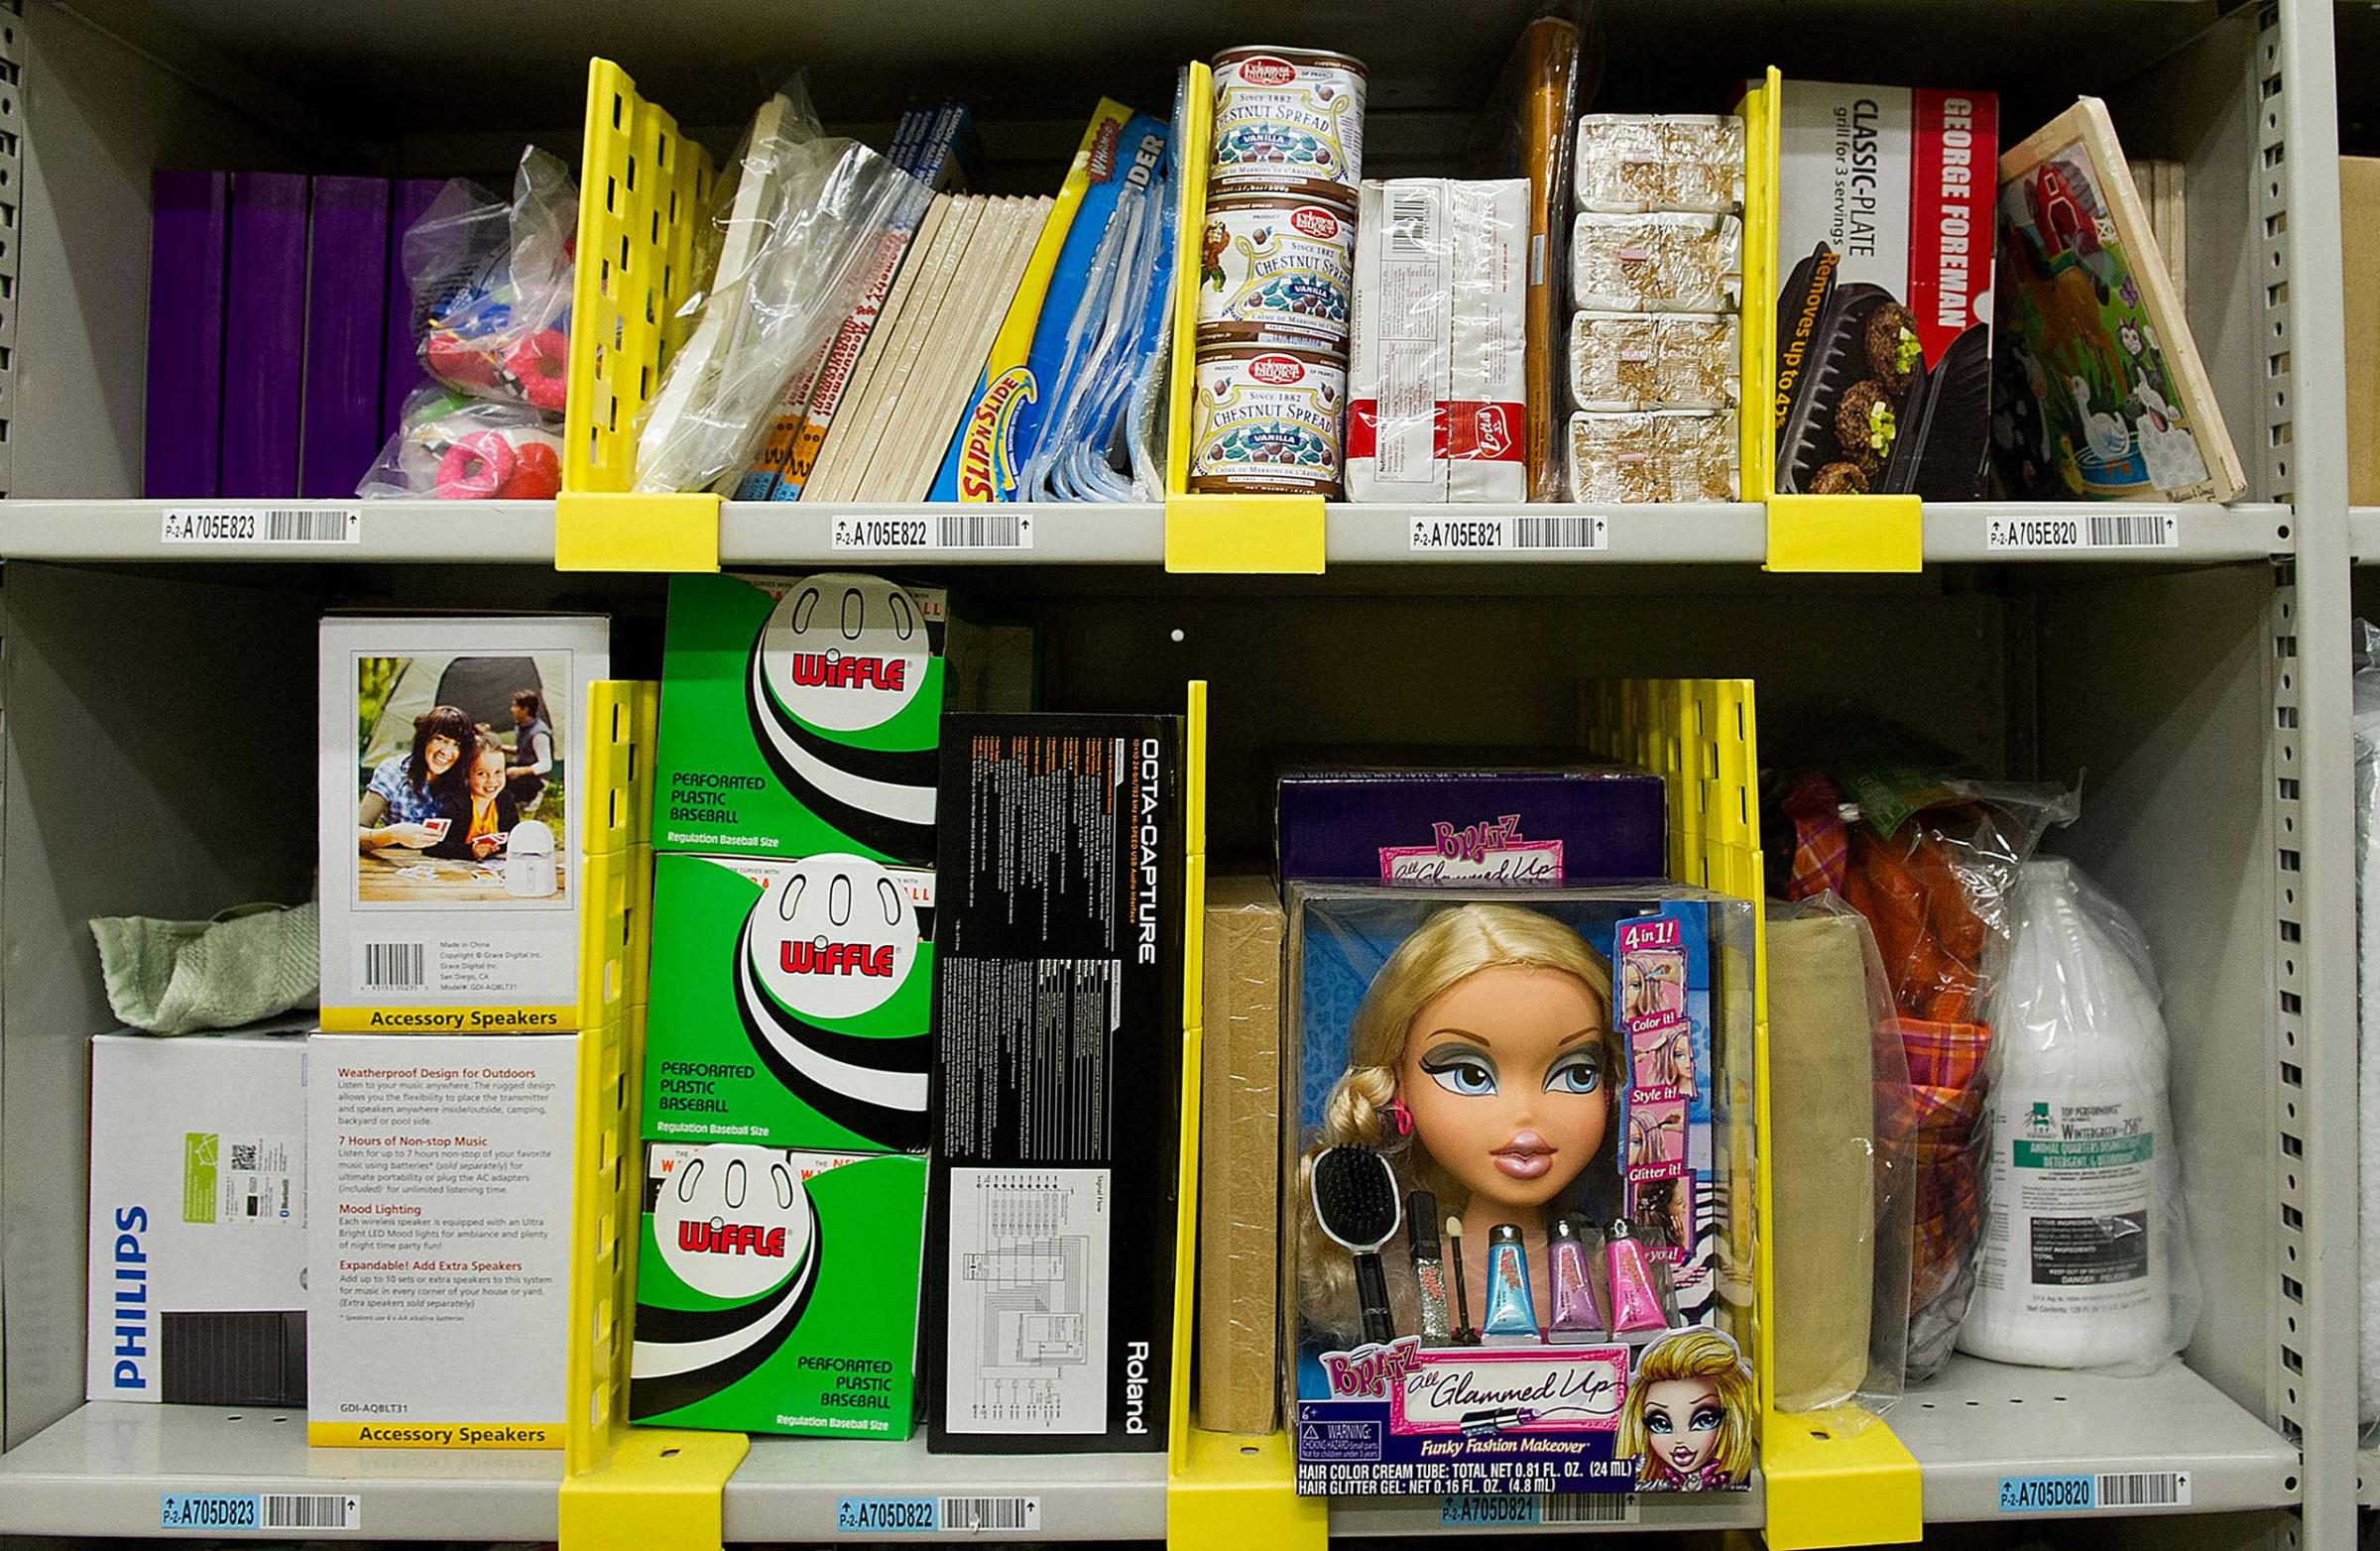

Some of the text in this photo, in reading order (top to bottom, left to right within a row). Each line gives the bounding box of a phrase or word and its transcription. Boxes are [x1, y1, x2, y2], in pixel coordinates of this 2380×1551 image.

[1276, 104, 1329, 133] SPREAD
[1836, 106, 1849, 137] grill
[1091, 126, 1113, 176] WHAM-O
[1836, 140, 1849, 162] for
[1849, 99, 1878, 257] CLASSIC-PLATE
[1831, 179, 1846, 245] servings
[1938, 98, 1972, 328] GEORGE FOREMAN
[1317, 245, 1334, 258] 1882
[1254, 254, 1320, 278] CHESTNUT
[1294, 286, 1328, 298] VANILLA
[1796, 253, 1841, 337] Removes
[1783, 341, 1806, 366] up
[822, 322, 870, 417] Measurement
[1778, 369, 1799, 389] to
[975, 378, 1018, 426] SLIDE
[1278, 394, 1301, 403] 1882
[1214, 404, 1332, 433] CHESTNUT SPREAD
[1253, 434, 1295, 443] VANILLA
[1480, 412, 1501, 451] Lotus
[963, 438, 994, 502] SLIP
[672, 773, 766, 790] PERFORATED
[671, 789, 726, 805] PLASTIC
[670, 807, 739, 823] BASEBALL
[667, 831, 778, 848] Regulation Baseball Size
[1138, 739, 1158, 964] OCTA-CAPTURE
[1129, 891, 1137, 923] Interface
[1624, 922, 1674, 948] 4 in 1!
[371, 1011, 557, 1027] Accessory Speakers
[1632, 1012, 1675, 1033] Color it!
[338, 1068, 536, 1080] Weatherproof Design for Outdoors
[660, 1061, 755, 1079] PERFORATED
[660, 1079, 715, 1095] PLASTIC
[1633, 1087, 1677, 1103] Style it!
[659, 1097, 729, 1113] BASEBALL
[657, 1122, 770, 1136] Regulation Baseball Size
[338, 1135, 488, 1147] 7 Hours of Non-stop Music
[1629, 1163, 1682, 1182] Glitter it!
[1095, 1175, 1104, 1195] Signal
[339, 1204, 421, 1217] Mood Lighting
[351, 1242, 374, 1251] night
[399, 1242, 421, 1252] party
[339, 1260, 523, 1271] Expandable! Add Extra Speakers
[114, 1206, 148, 1388] PHILIPS
[797, 1357, 892, 1373] PERFORATED
[837, 1376, 892, 1390] PLASTIC
[1127, 1342, 1148, 1434] Roland
[1431, 1371, 1557, 1408] Glammed
[1559, 1369, 1614, 1402] Up
[821, 1393, 891, 1408] BASEBALL
[776, 1414, 889, 1430] Regulation Baseball Size
[1301, 1406, 1318, 1420] 6+
[359, 1427, 545, 1445] Accessory Speakers
[1327, 1424, 1371, 1439] WARNING:
[1421, 1439, 1587, 1458] Funky Fashion Makeover
[1299, 1464, 1327, 1480] HAIR
[1330, 1465, 1369, 1480] COLOR
[1372, 1464, 1413, 1480] CREAM
[1416, 1464, 1450, 1479] TUBE:
[1452, 1463, 1488, 1478] TOTAL
[1490, 1463, 1512, 1478] NET
[1515, 1463, 1539, 1478] 0.81
[1543, 1462, 1560, 1478] FL.
[1564, 1462, 1583, 1477] OZ.
[1590, 1461, 1607, 1478] (24
[1299, 1480, 1327, 1495] HAIR
[1332, 1480, 1379, 1495] GLITTER
[1381, 1480, 1406, 1495] GEL:
[1409, 1480, 1431, 1494] NET
[1434, 1479, 1459, 1493] 0.16
[1463, 1479, 1480, 1493] FL.
[1486, 1479, 1501, 1493] OZ.
[1508, 1478, 1532, 1493] (4.8
